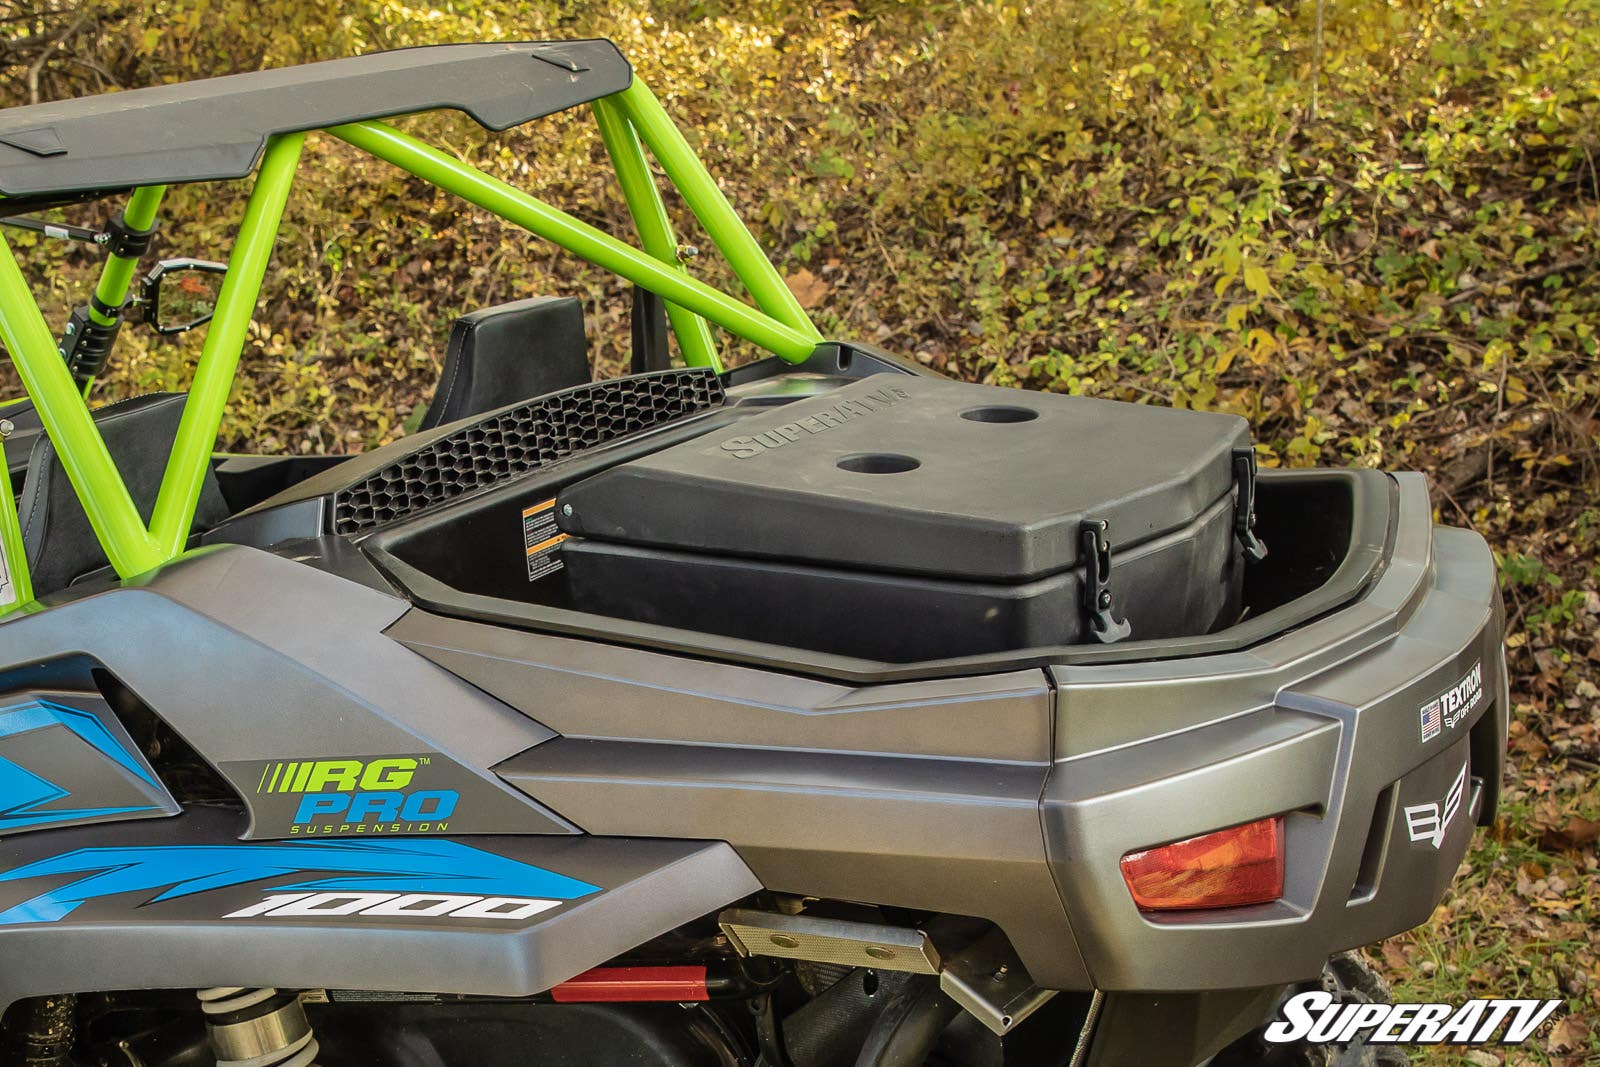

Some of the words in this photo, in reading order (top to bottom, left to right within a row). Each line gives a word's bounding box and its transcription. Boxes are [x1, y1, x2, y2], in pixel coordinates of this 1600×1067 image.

[1440, 662, 1481, 716] TEXTRON
[1460, 701, 1470, 719] OFF
[293, 790, 460, 824] PRO
[290, 823, 449, 834] SUSPENSION
[222, 892, 563, 919] 1000
